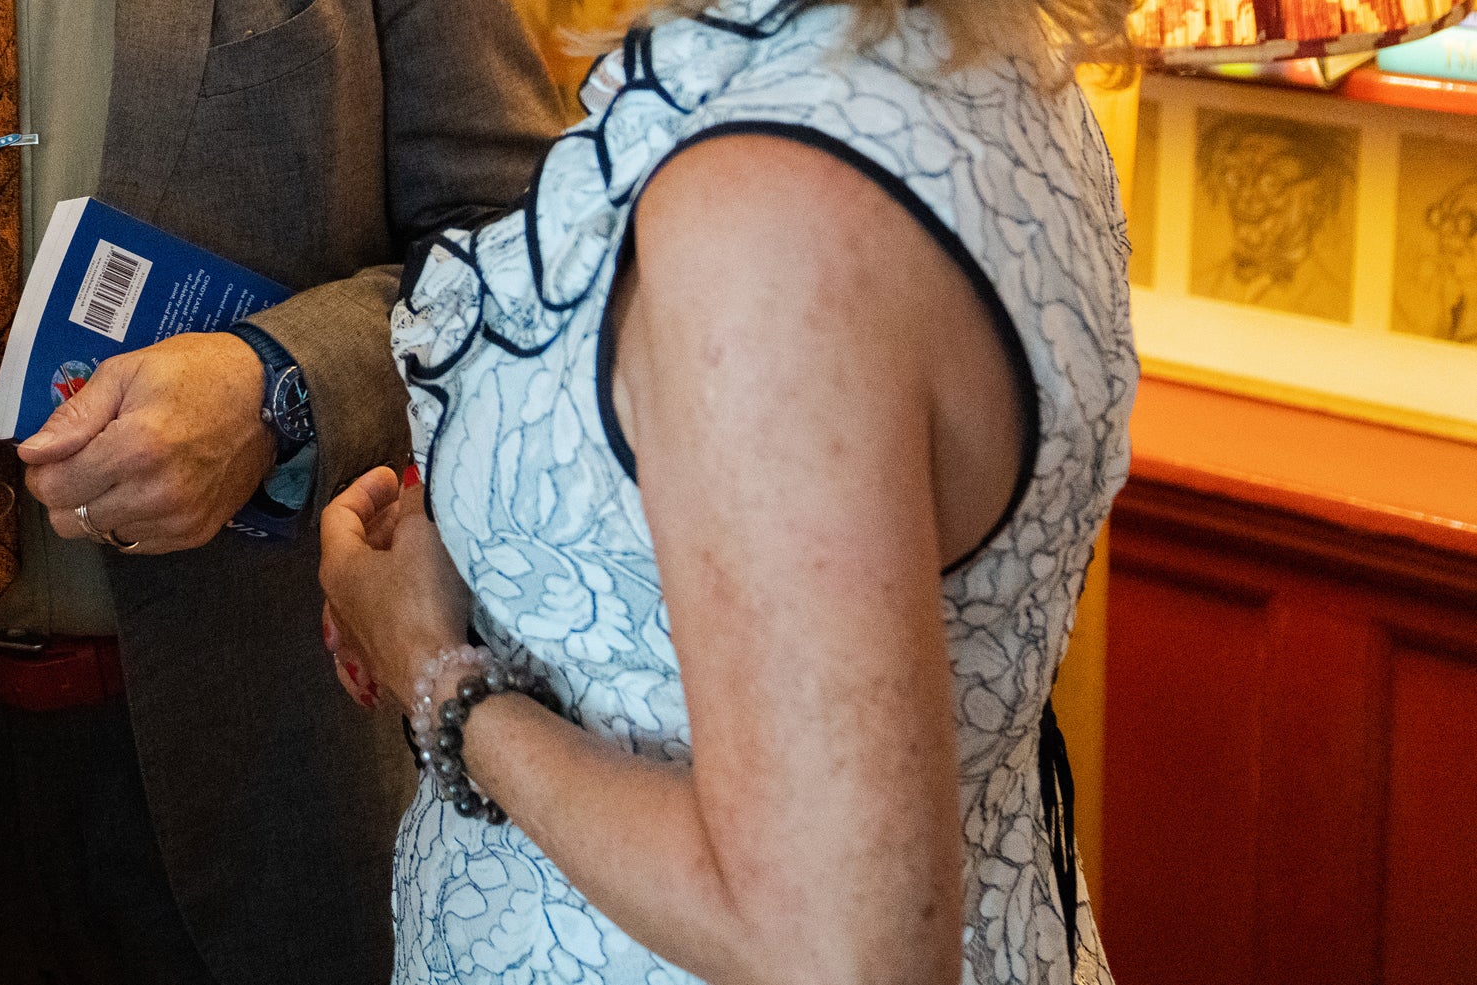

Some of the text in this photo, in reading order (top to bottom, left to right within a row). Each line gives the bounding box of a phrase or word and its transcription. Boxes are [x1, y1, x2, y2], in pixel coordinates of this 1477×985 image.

[191, 269, 205, 290] finding
[198, 275, 211, 297] CINDY
[175, 281, 190, 308] celebrity
[182, 290, 195, 316] yourself
[219, 283, 234, 310] Cheered
